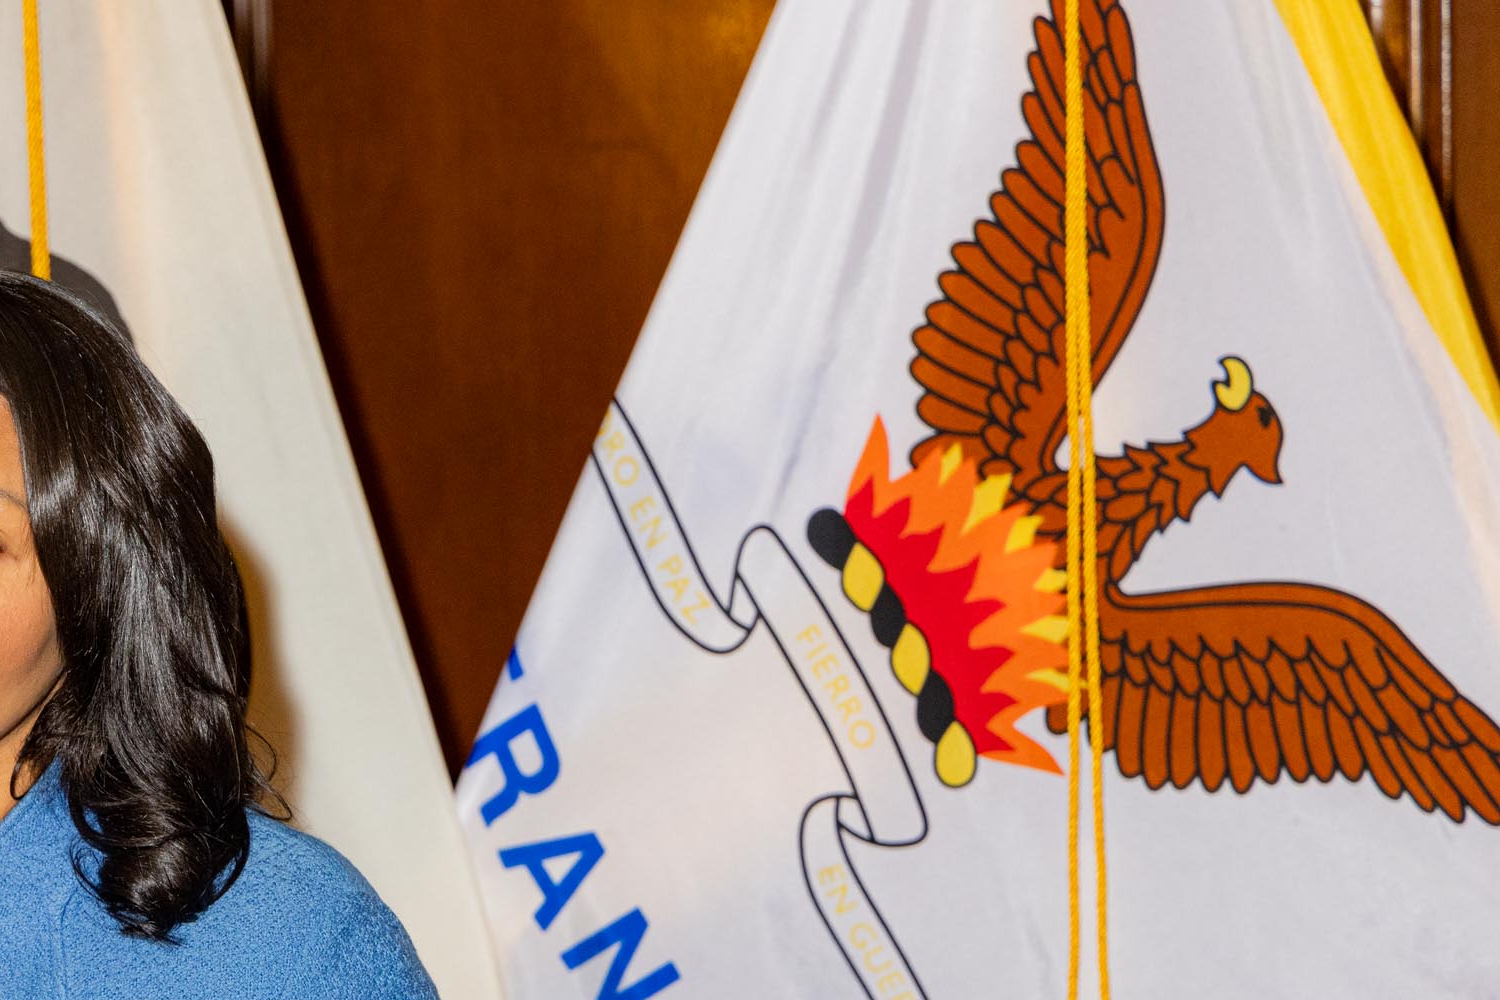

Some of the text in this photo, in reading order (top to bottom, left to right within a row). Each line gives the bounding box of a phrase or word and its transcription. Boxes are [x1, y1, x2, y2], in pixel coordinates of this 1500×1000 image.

[629, 494, 669, 550] EN
[657, 553, 712, 626] PAZ
[795, 623, 877, 750] FIERRO
[817, 863, 857, 916] EN
